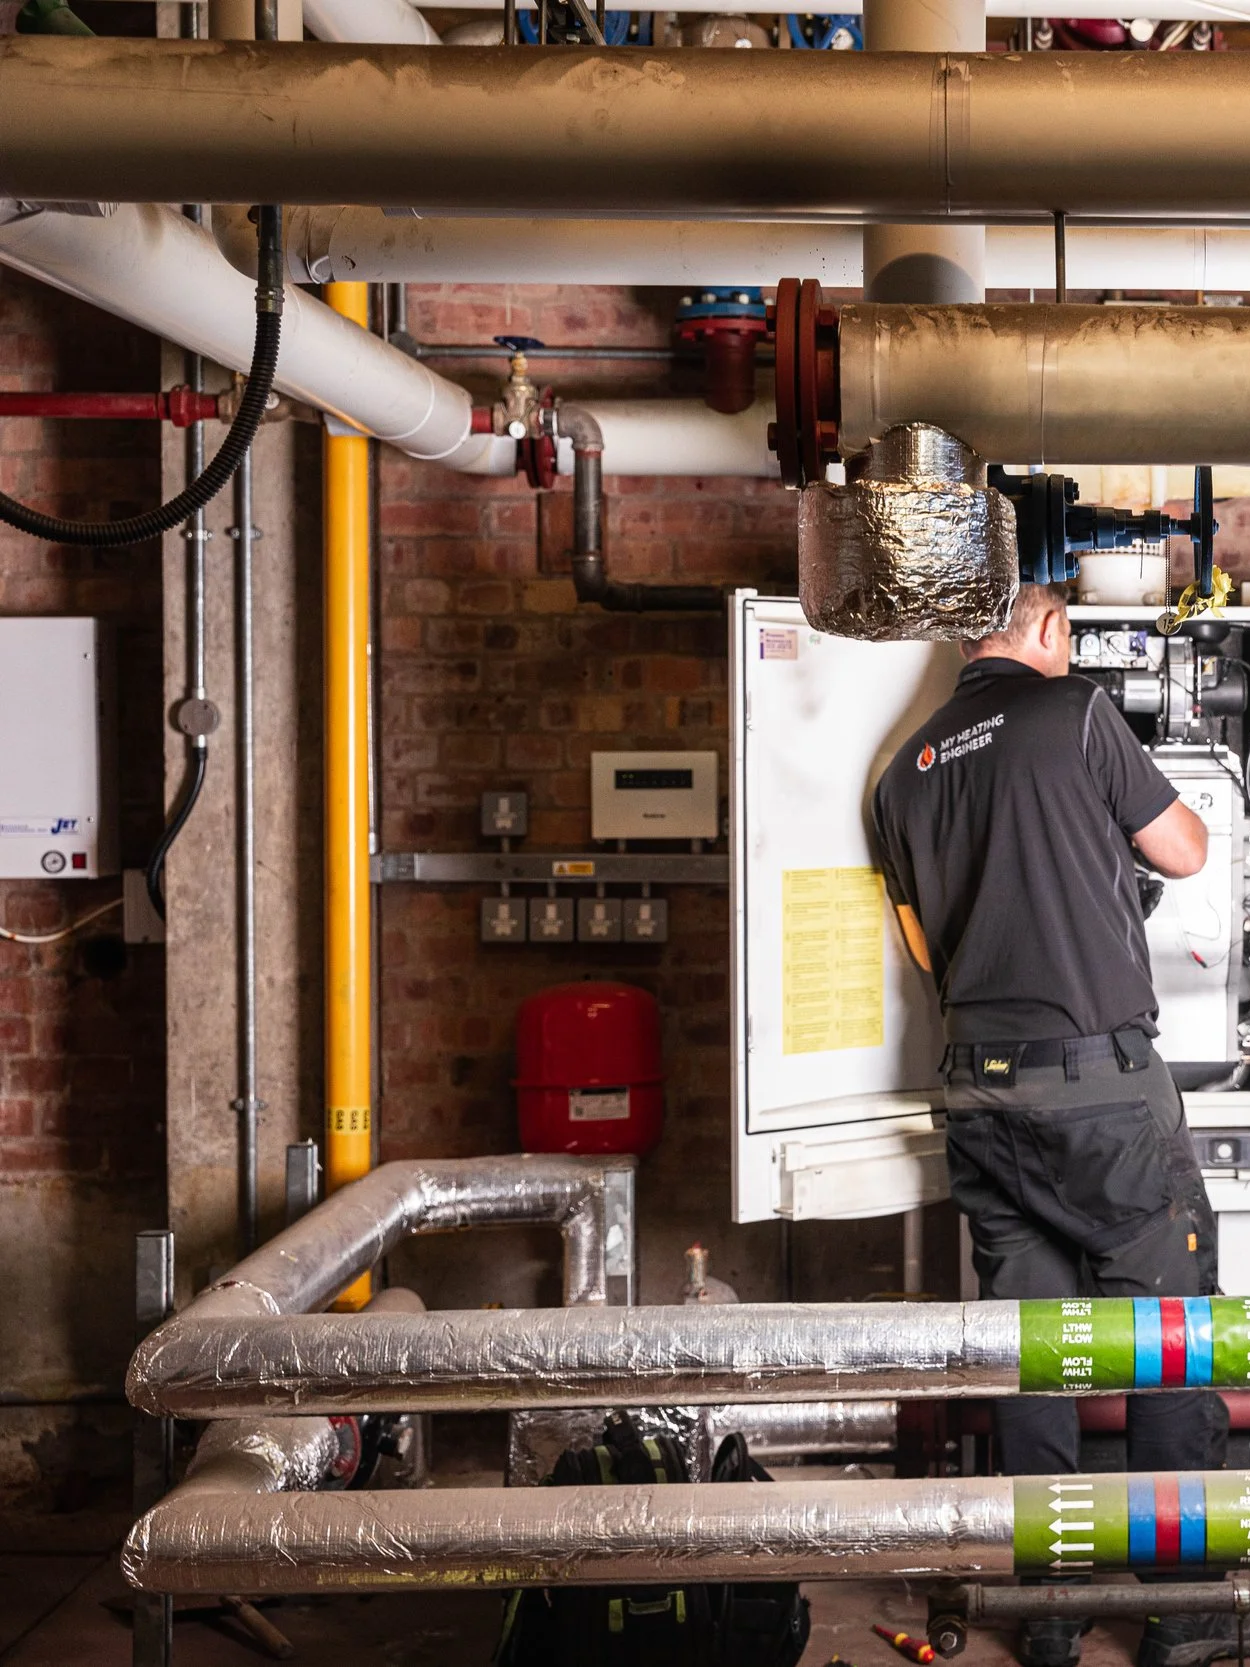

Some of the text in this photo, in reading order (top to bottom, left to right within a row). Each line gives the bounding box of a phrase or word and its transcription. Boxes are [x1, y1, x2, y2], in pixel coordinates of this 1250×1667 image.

[940, 714, 1004, 751] MY HEATING
[940, 732, 992, 764] ENGINEER
[1063, 1323, 1092, 1333] LTHW
[1062, 1333, 1093, 1344] FLOW
[1062, 1356, 1092, 1367] FLOW
[1063, 1367, 1092, 1376] LTHW
